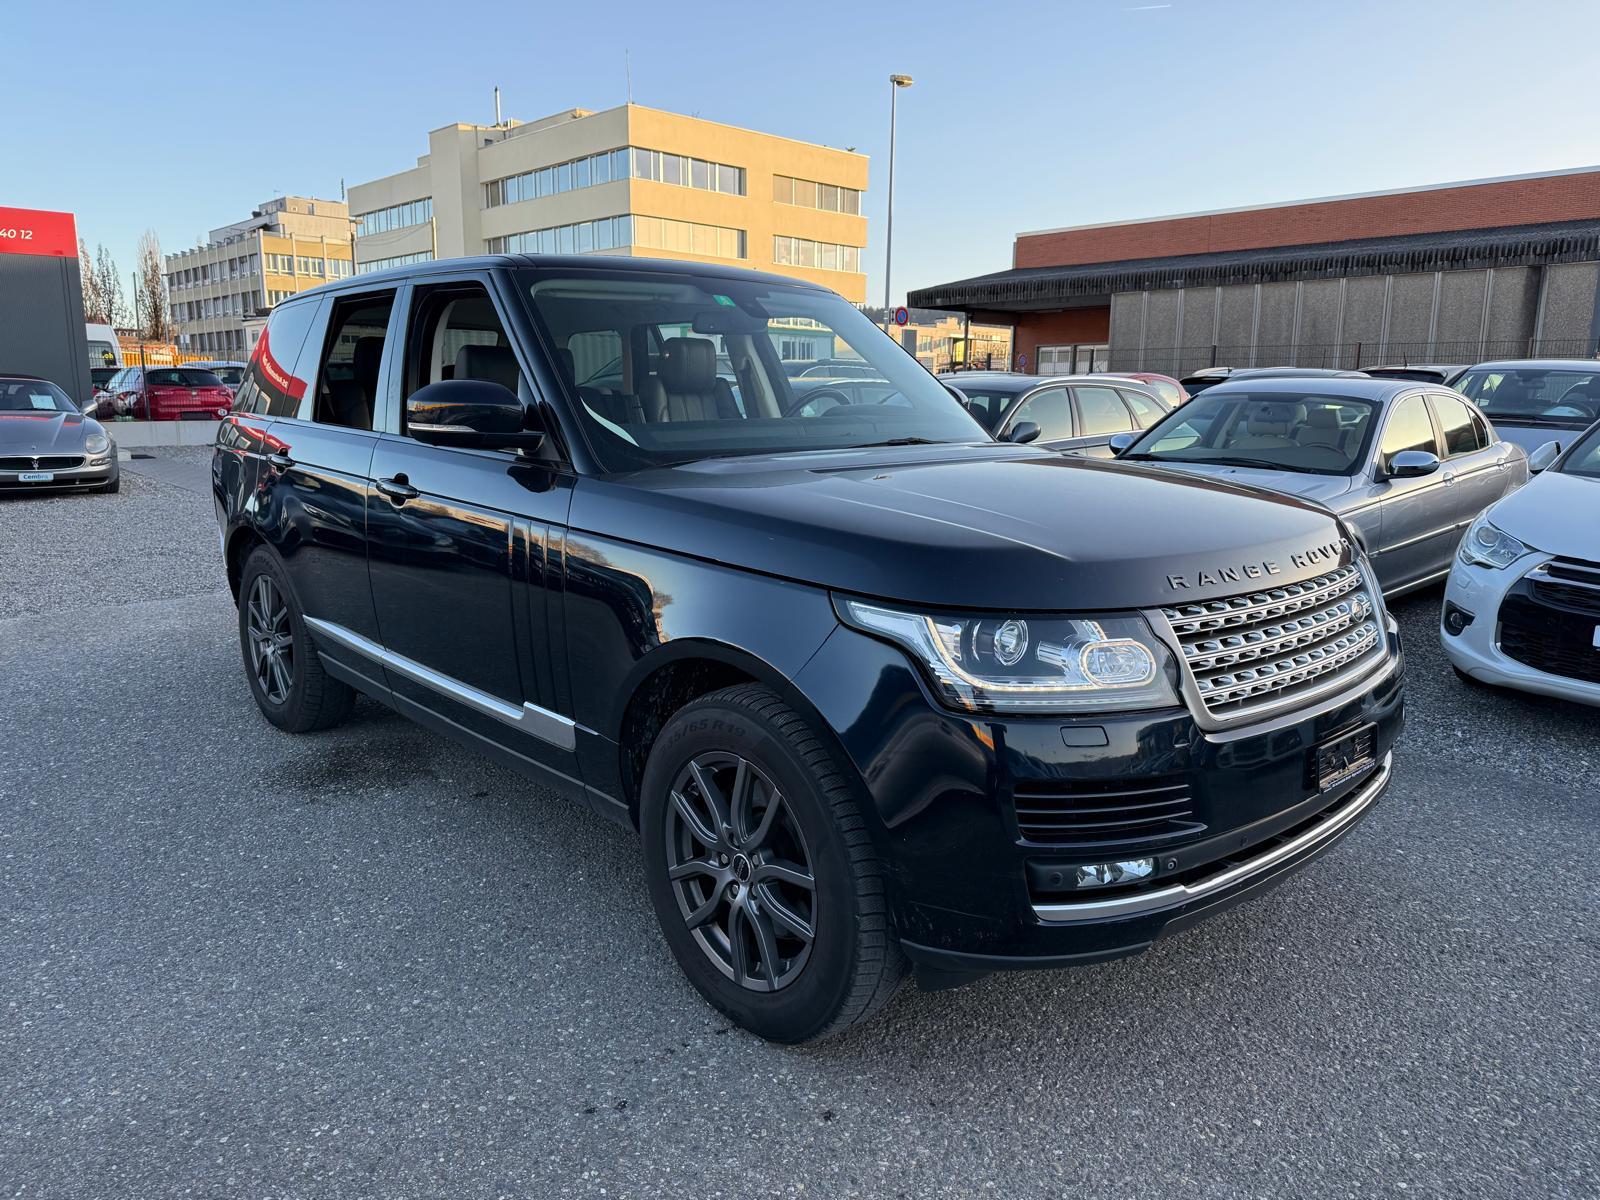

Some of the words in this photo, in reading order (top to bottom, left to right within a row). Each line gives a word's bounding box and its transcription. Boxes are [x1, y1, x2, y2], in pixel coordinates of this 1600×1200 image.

[0, 228, 17, 239] 40
[20, 229, 33, 240] 12
[1166, 560, 1281, 590] RANGE
[1290, 537, 1351, 569] ROVER
